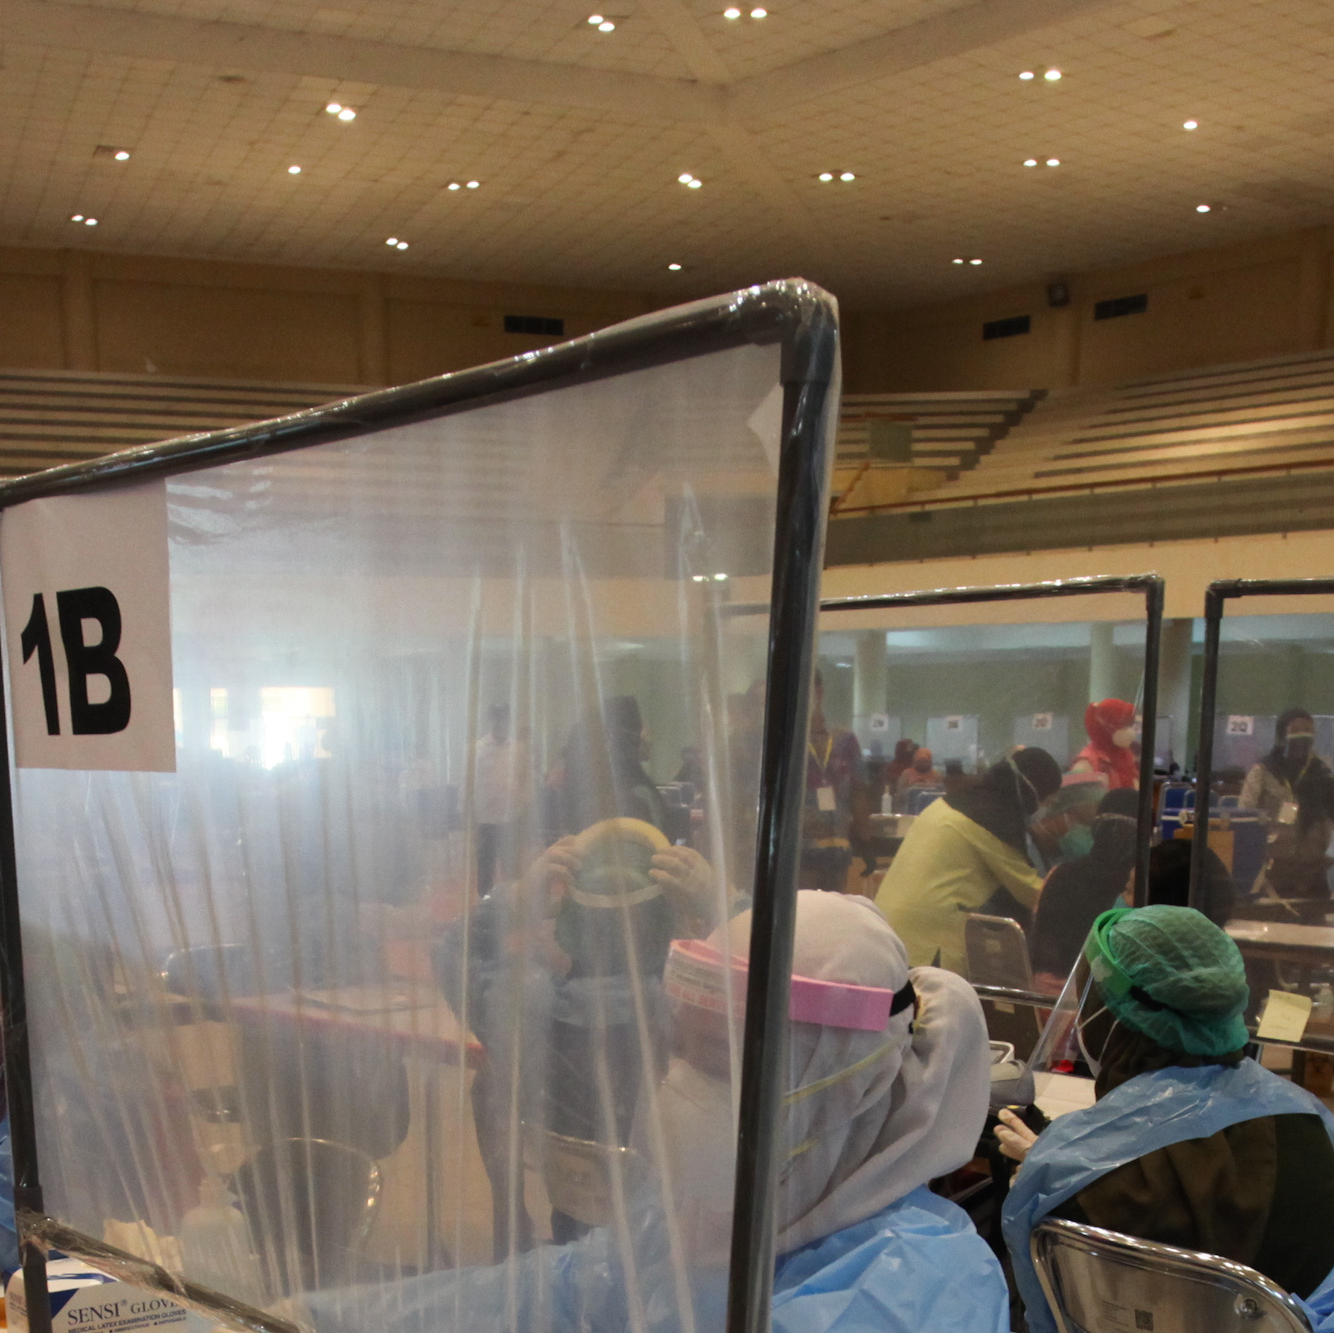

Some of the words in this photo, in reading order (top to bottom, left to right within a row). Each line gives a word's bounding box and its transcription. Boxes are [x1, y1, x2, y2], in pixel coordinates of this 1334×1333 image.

[21, 586, 131, 736] 1B
[97, 1320, 118, 1330] LATEX
[118, 1314, 161, 1326] EXAMINATION
[161, 1309, 187, 1319] GLOVES
